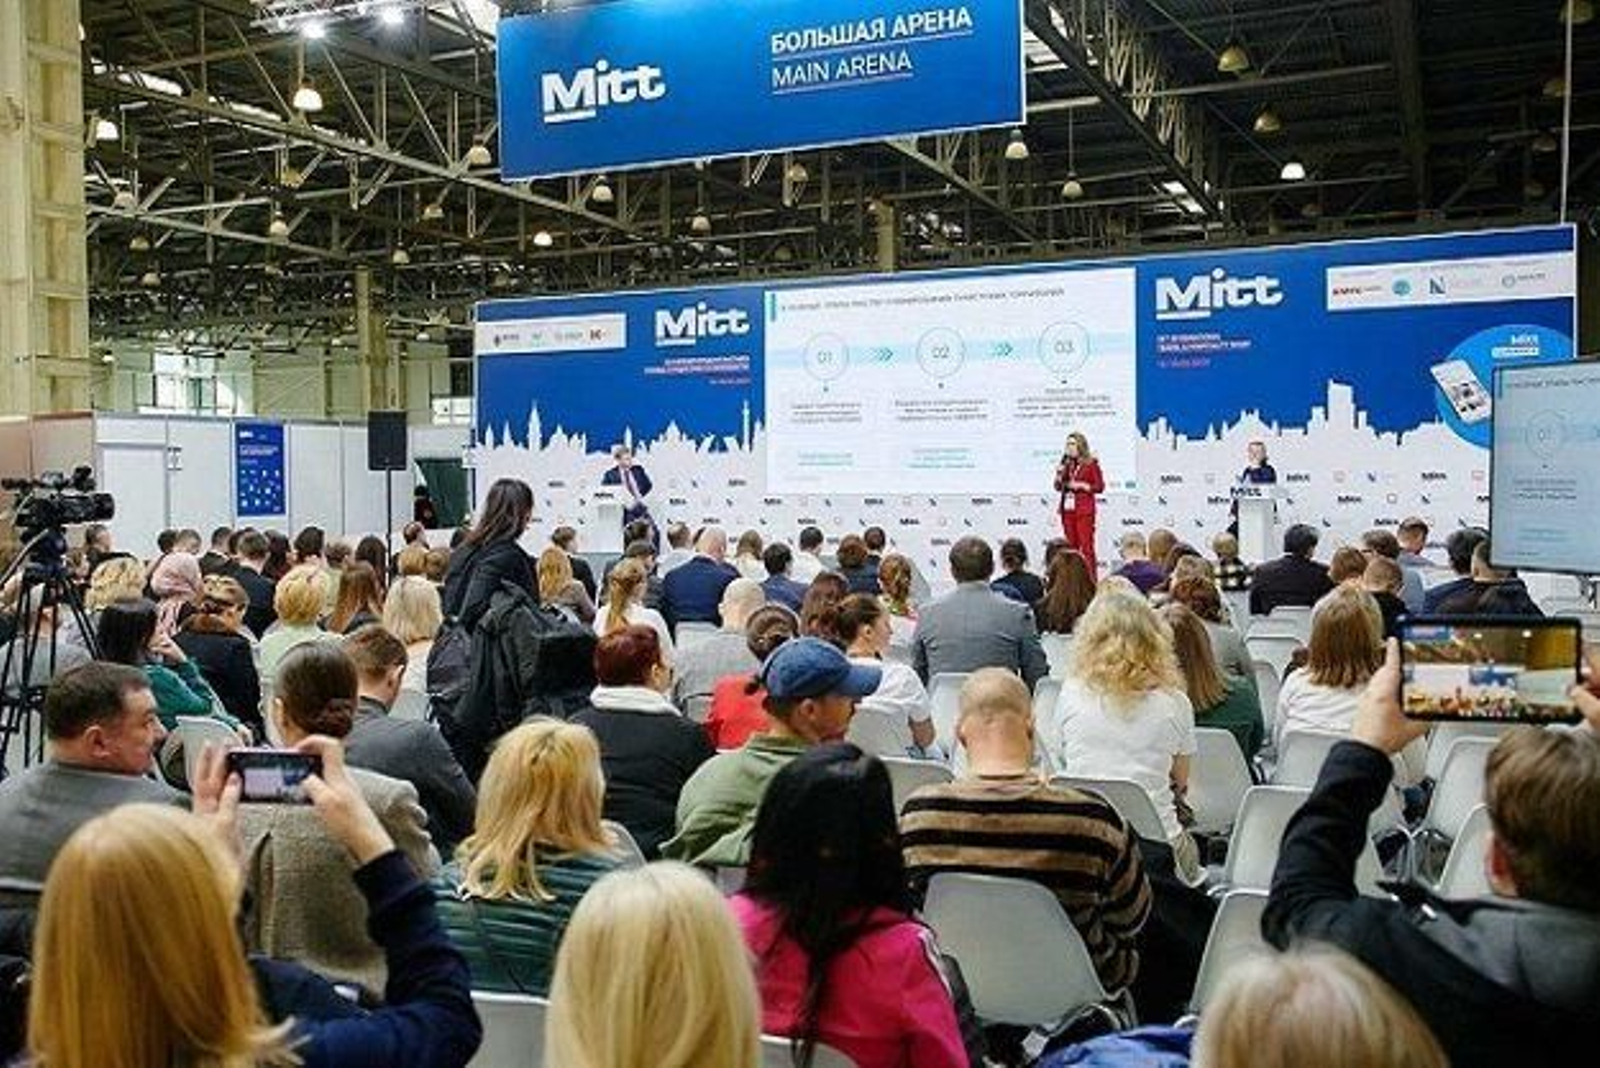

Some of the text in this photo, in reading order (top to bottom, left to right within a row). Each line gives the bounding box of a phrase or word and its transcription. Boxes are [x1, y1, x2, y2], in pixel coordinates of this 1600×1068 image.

[770, 6, 973, 54] БОЛЬШАЯ АРЕНА
[541, 59, 667, 121] Mitt
[771, 49, 913, 88] MAIN ARENA
[1155, 267, 1284, 320] Mitt
[654, 300, 750, 346] Mitt
